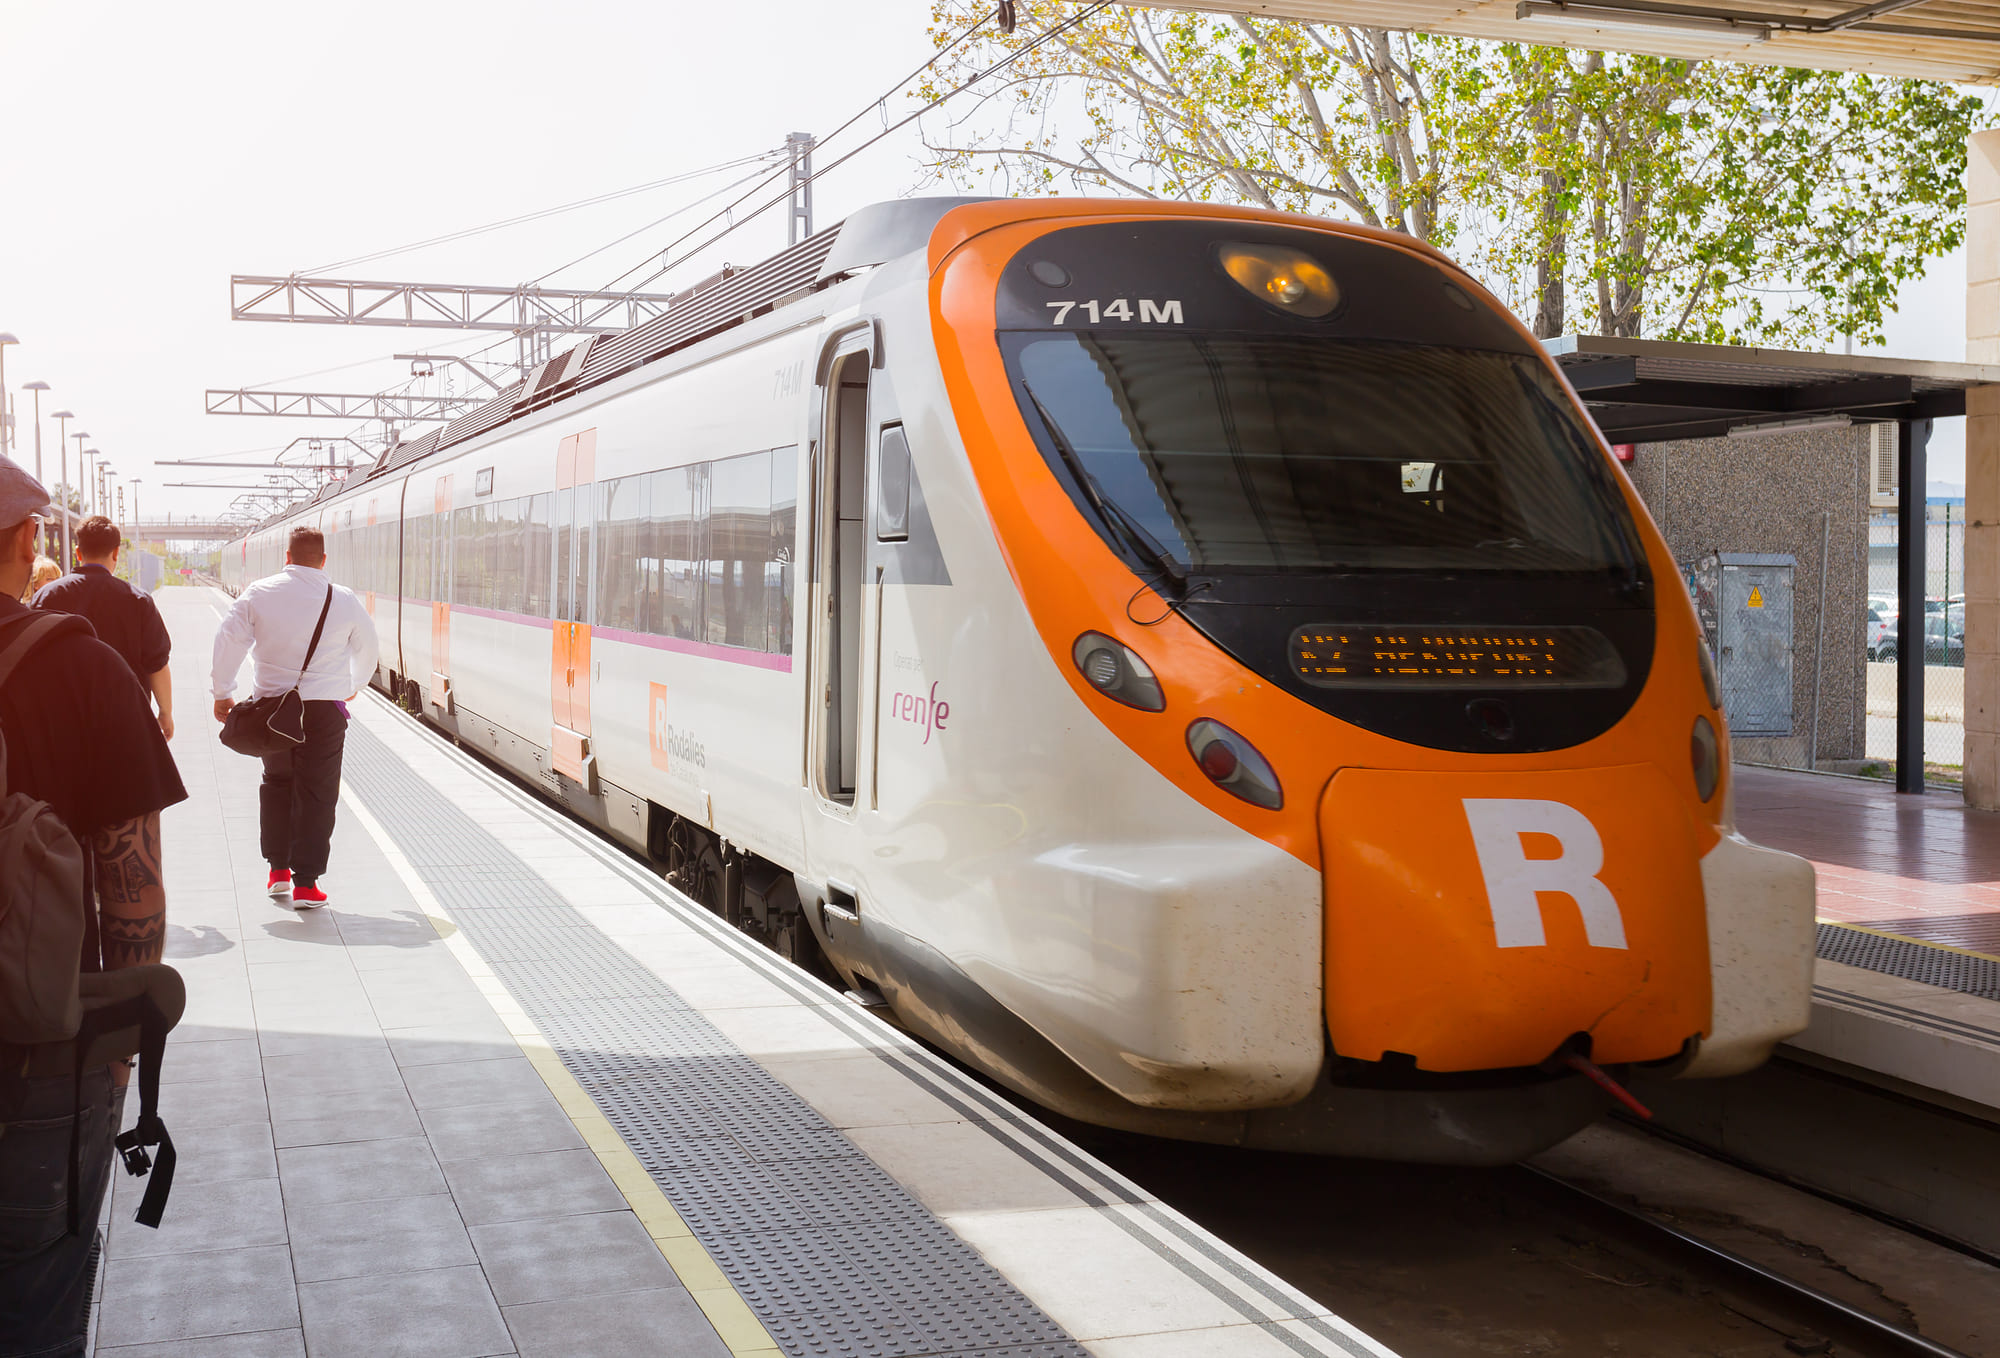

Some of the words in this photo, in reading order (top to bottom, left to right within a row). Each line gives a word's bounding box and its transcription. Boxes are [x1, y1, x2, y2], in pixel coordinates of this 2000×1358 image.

[1046, 299, 1184, 325] 714M
[773, 360, 804, 400] 714M
[893, 681, 949, 744] renfe
[668, 724, 705, 768] Rodalies
[1461, 798, 1628, 949] R
